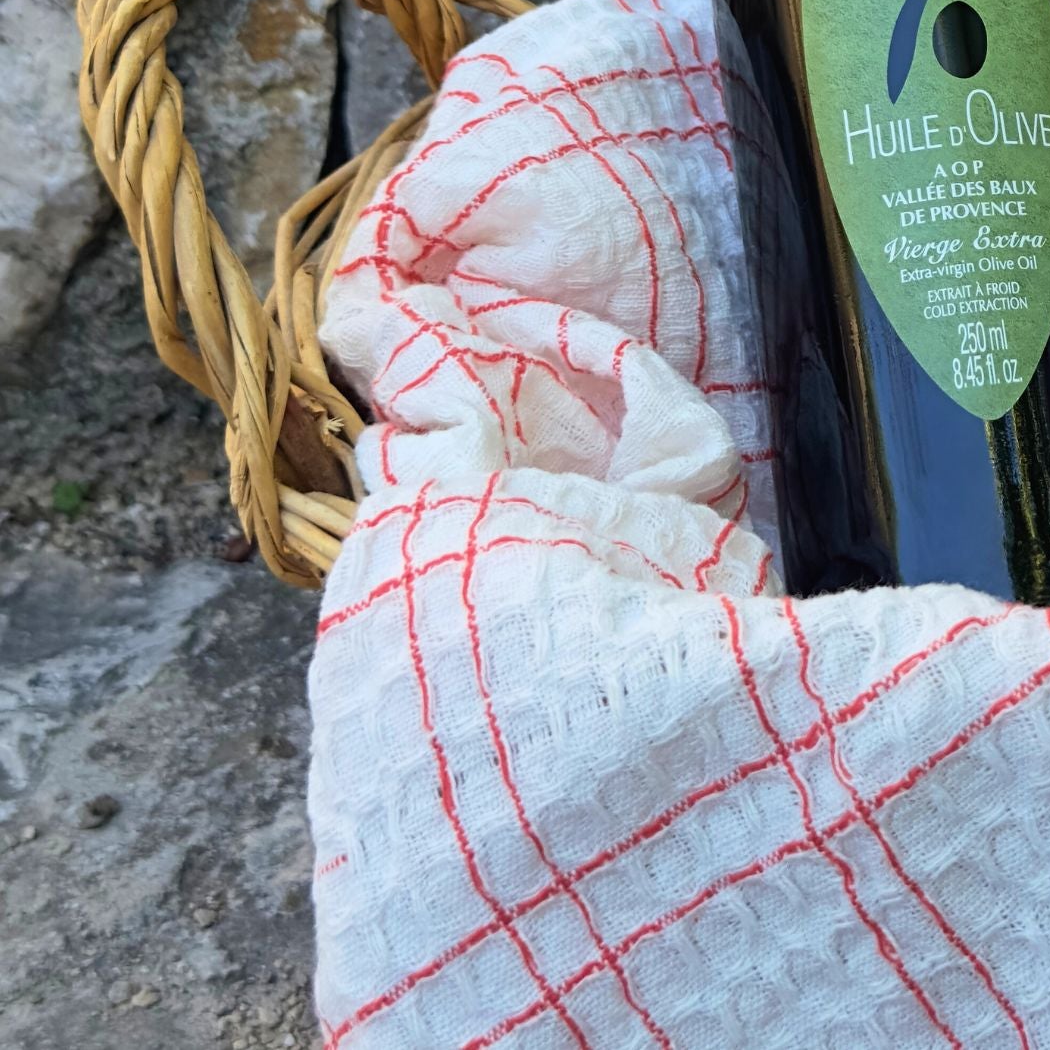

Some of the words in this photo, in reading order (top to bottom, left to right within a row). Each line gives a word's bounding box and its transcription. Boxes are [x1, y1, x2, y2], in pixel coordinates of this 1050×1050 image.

[843, 103, 942, 165] HUILE
[881, 183, 946, 208] VALLÉE
[951, 181, 985, 198] DES
[990, 180, 1037, 196] BAUX
[900, 209, 926, 227] DE
[930, 201, 1027, 222] PROVENCE
[884, 236, 964, 265] Vierge
[973, 225, 1047, 251] Extra
[900, 261, 975, 283] Extra-virgin
[978, 256, 1014, 272] Olive
[1017, 255, 1038, 270] Oil
[928, 284, 972, 302] EXTRAIT
[975, 281, 983, 296] À
[986, 281, 1020, 295] FROID
[923, 303, 956, 319] COLD
[960, 297, 1028, 314] EXTRACTION
[958, 321, 986, 355] 250
[989, 319, 1008, 351] ml
[953, 355, 985, 389] 8.45
